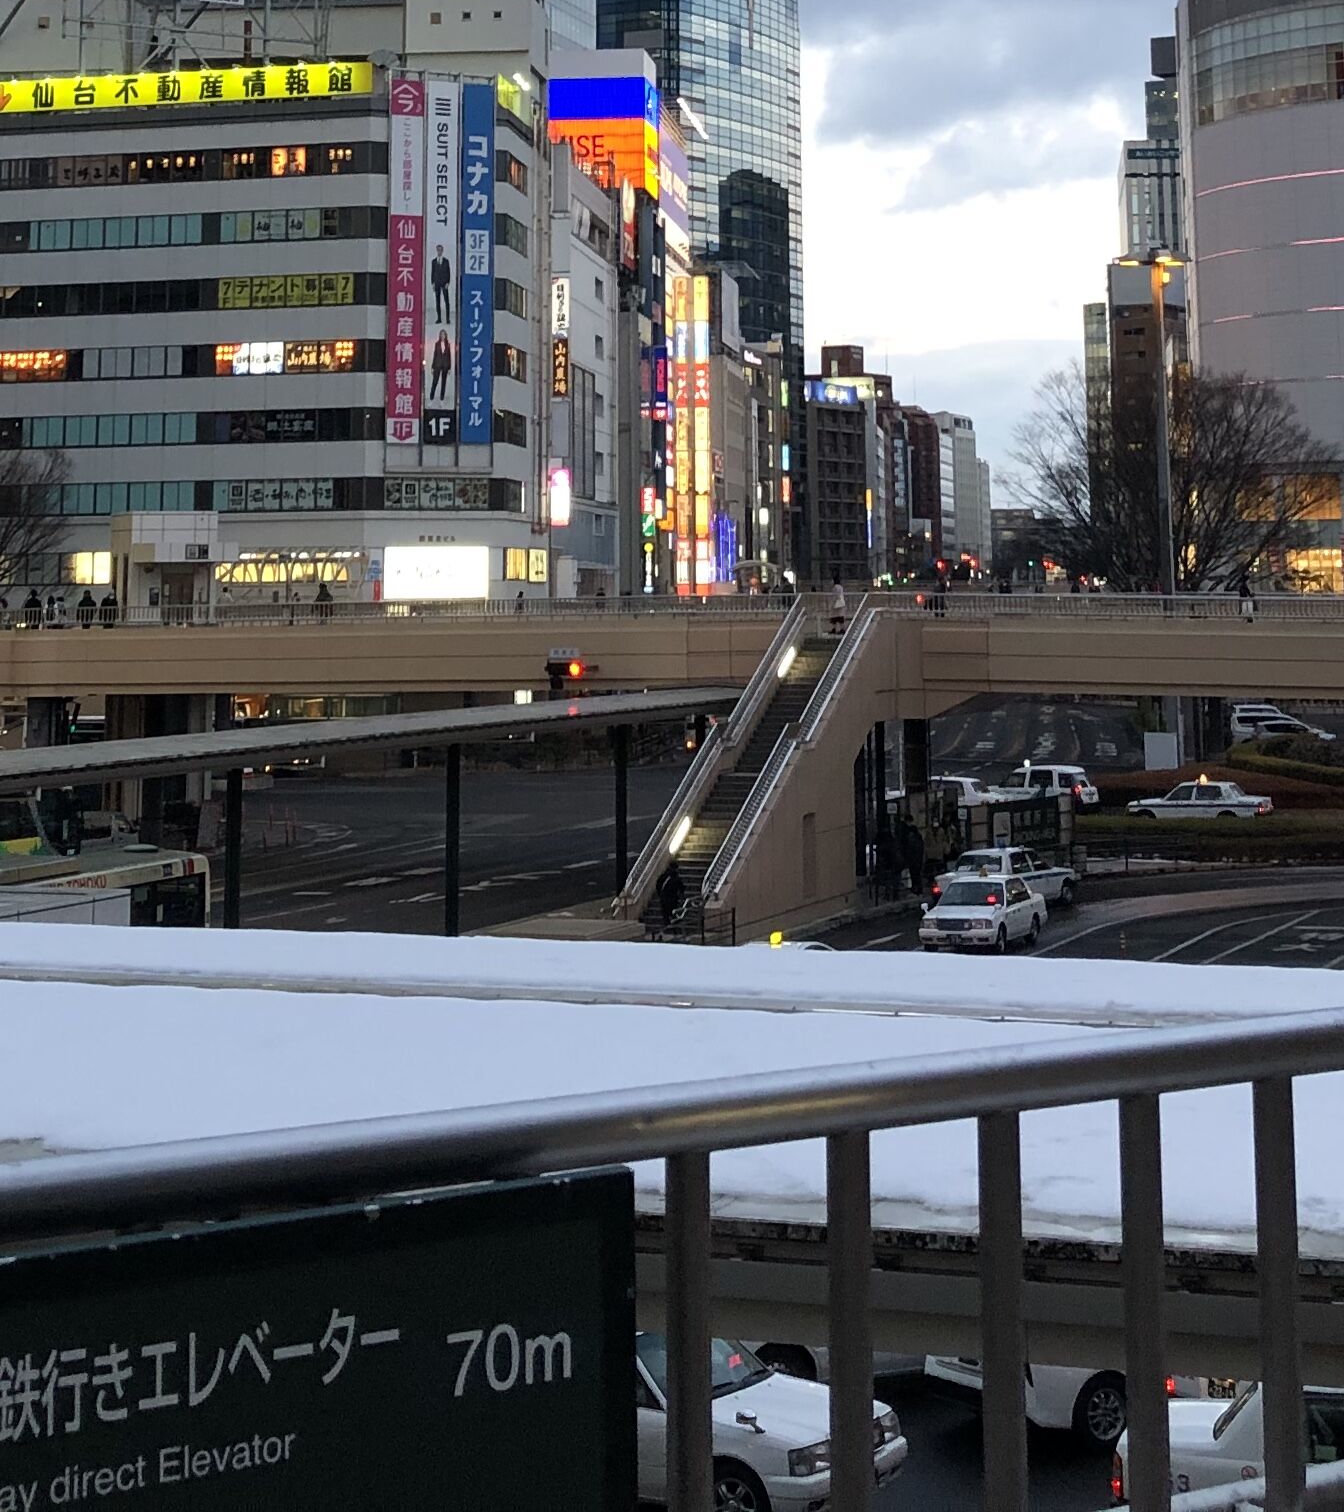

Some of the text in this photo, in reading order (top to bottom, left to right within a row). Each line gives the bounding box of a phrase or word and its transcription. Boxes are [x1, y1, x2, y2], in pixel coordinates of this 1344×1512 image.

[32, 66, 353, 109] 仙台不動産情報館
[436, 122, 449, 227] SUIT SELECT
[467, 135, 489, 216] コナカ
[470, 233, 486, 250] 3F
[470, 257, 486, 272] 2F
[395, 219, 416, 414] 仙台不動産情報館
[468, 290, 485, 427] スーツ・フォーマル
[395, 422, 411, 436] 1F
[429, 417, 451, 436] 1F
[446, 1322, 573, 1397] 70m
[49, 1456, 146, 1506] direct
[159, 1429, 298, 1484] Elevator
